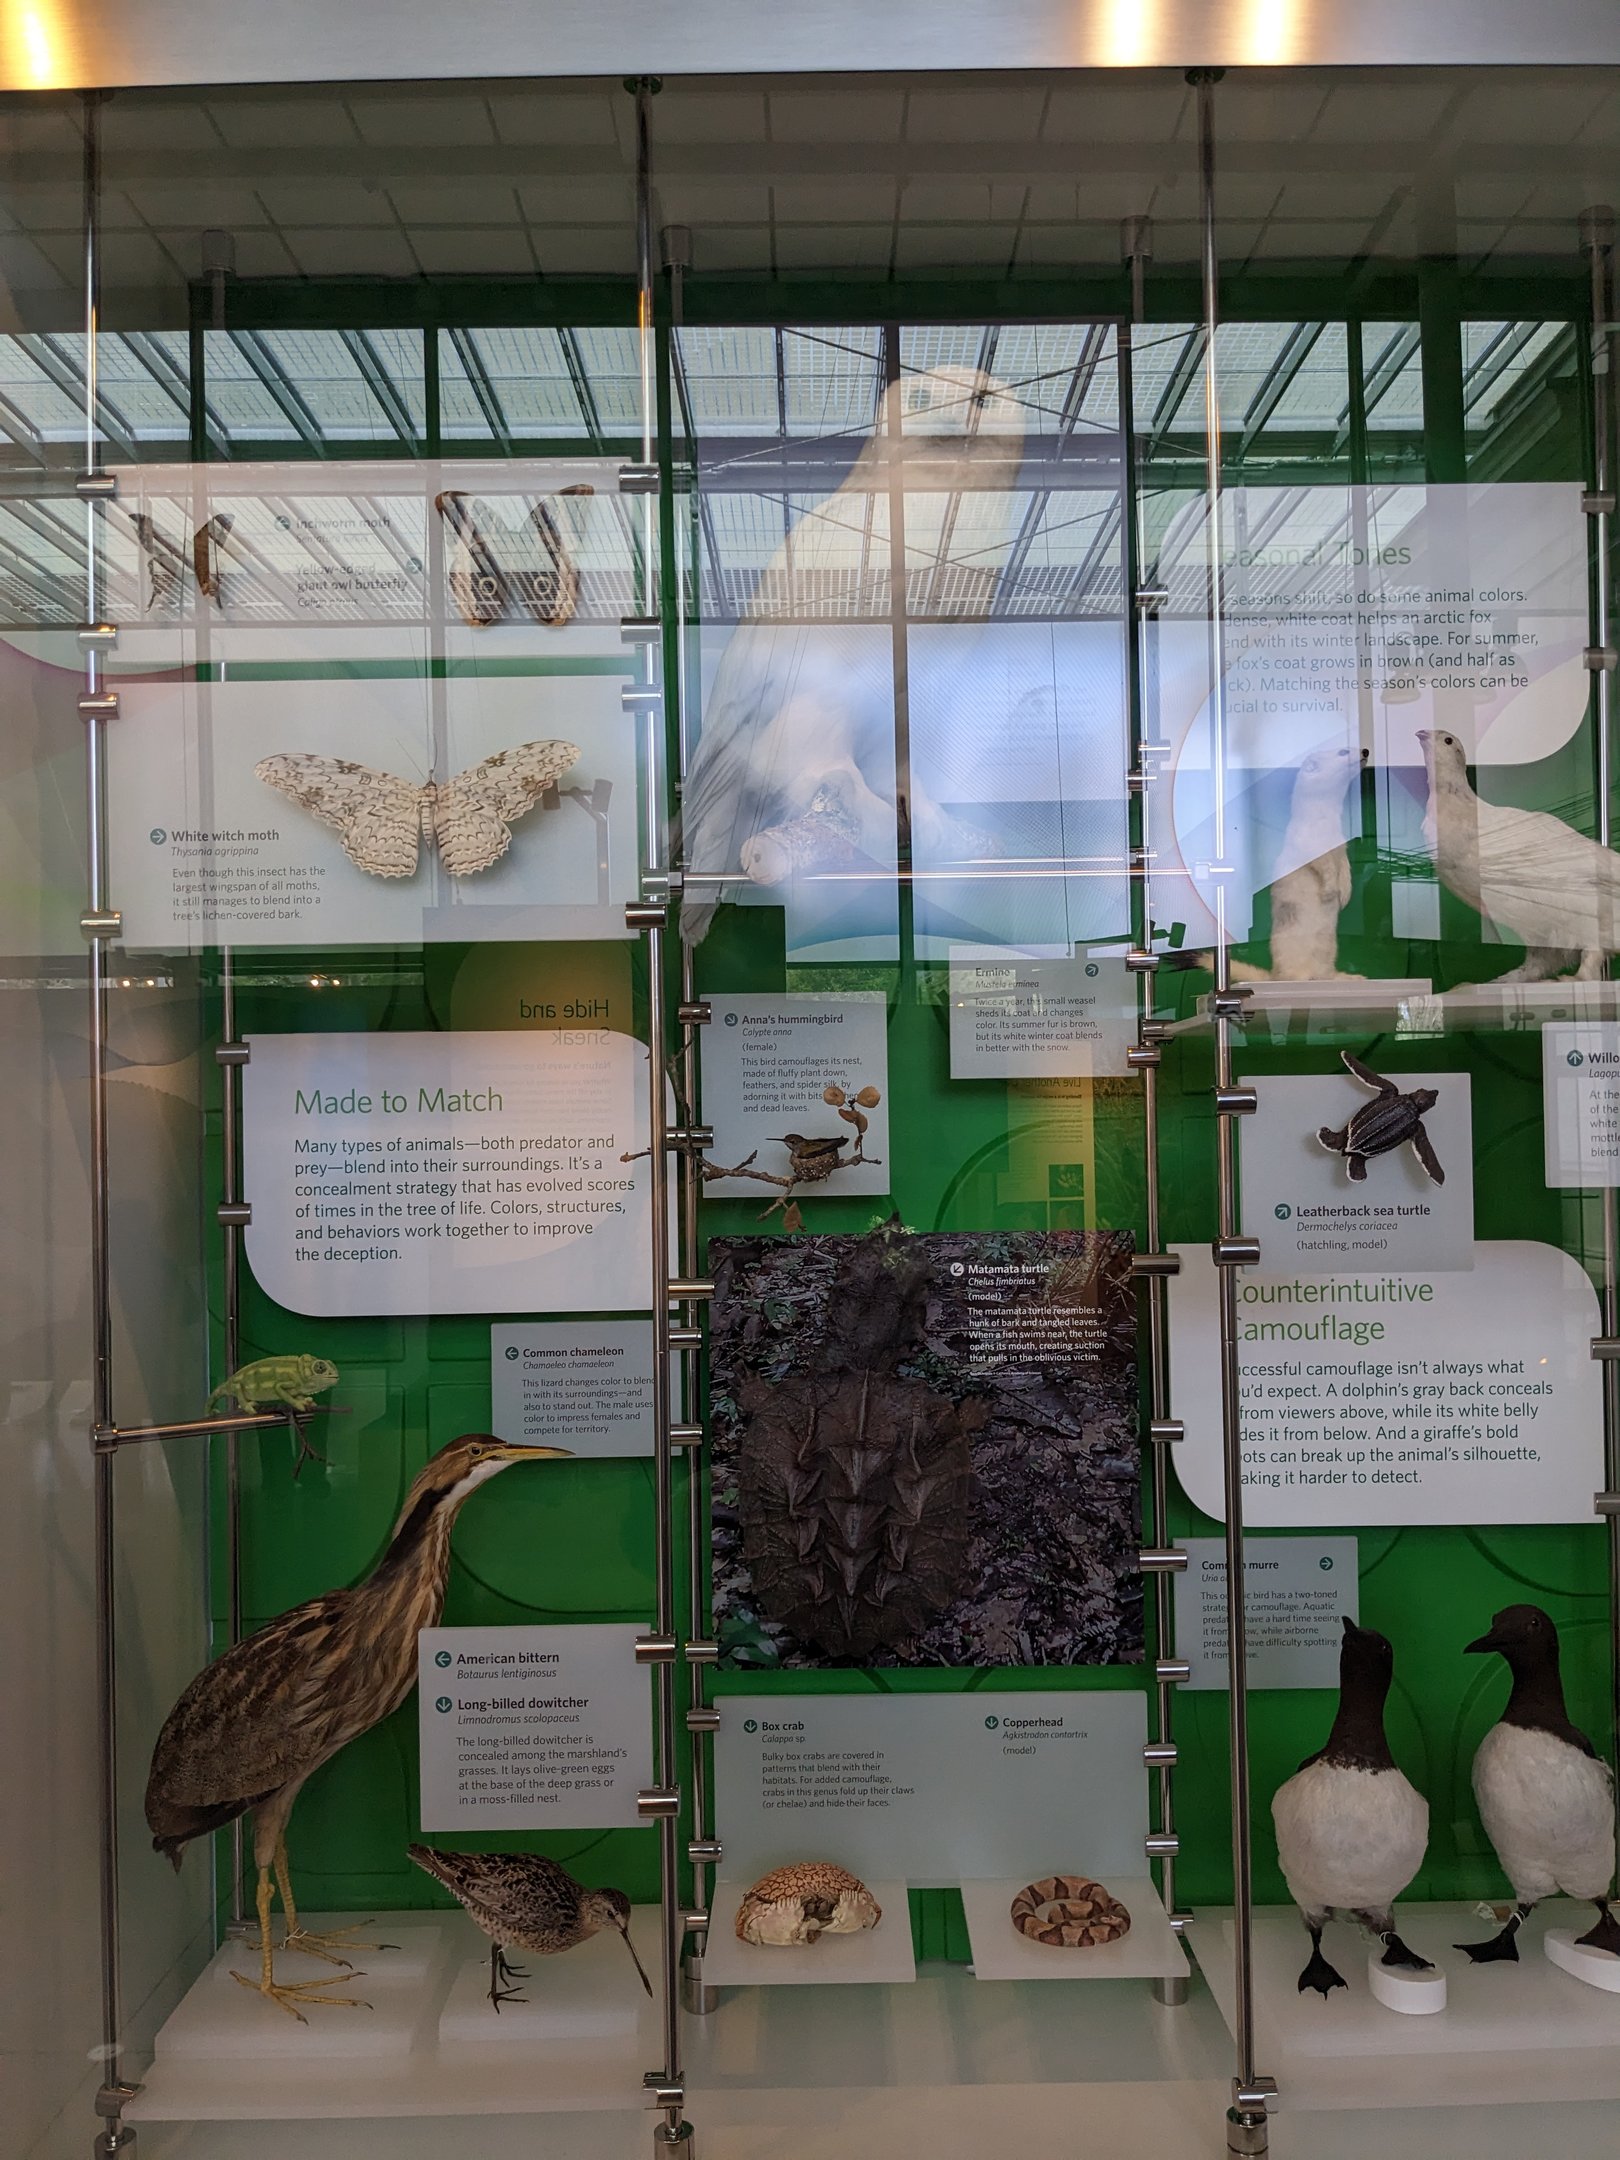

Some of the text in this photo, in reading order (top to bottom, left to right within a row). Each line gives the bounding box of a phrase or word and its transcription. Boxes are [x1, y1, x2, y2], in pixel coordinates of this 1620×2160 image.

[1223, 543, 1323, 568] easonal
[1230, 588, 1528, 606] seasons shift, so do some animal colors.
[1224, 634, 1251, 649] end
[1255, 634, 1286, 649] with
[1289, 633, 1308, 648] its
[1364, 630, 1443, 650] landscape.
[1447, 630, 1471, 646] For
[1475, 632, 1539, 649] summer,
[171, 829, 279, 841] White witch moth
[173, 865, 325, 879] Even though this insect has the
[173, 880, 320, 894] largest wingspan of all moths,
[742, 1013, 843, 1025] Anna's hummingbird
[975, 1021, 997, 1029] color.
[1000, 1020, 1009, 1028] Its
[1012, 1021, 1045, 1029] summer
[1047, 1020, 1058, 1028] fur
[1070, 1020, 1097, 1028] brown,
[741, 1042, 777, 1051] (female)
[1588, 1052, 1620, 1064] Willo
[295, 1088, 372, 1114] Made
[381, 1089, 407, 1113] to
[418, 1086, 502, 1112] Match
[295, 1133, 614, 1155] Many types of animals—both predator and
[295, 1156, 602, 1177] prey—blend into their surroundings. It's a
[295, 1177, 635, 1197] concealment strategy that has evolved scores
[295, 1199, 625, 1217] of times in the tree of life. Colors, structures,
[1297, 1204, 1430, 1217] Leatherback sea turtle
[296, 1220, 593, 1239] and behaviors work together to improve
[1297, 1220, 1398, 1233] Dermochelys coriacea
[1297, 1238, 1387, 1252] (hatchling, model)
[295, 1245, 401, 1263] the deception.
[968, 1264, 1049, 1274] Matamata turtle
[968, 1292, 1002, 1301] (model)
[523, 1346, 624, 1357] Common chameleon
[1240, 1402, 1538, 1420] from viewers above, while its white belly
[523, 1425, 610, 1436] compete for territory.
[1240, 1468, 1421, 1487] aking it harder to detect.
[1249, 1561, 1279, 1569] murre
[457, 1652, 559, 1664] American bittern
[458, 1696, 589, 1712] Long-billed dowitcher
[762, 1721, 804, 1731] Box crab
[1003, 1716, 1063, 1728] Copperhead
[1003, 1745, 1036, 1755] (model)
